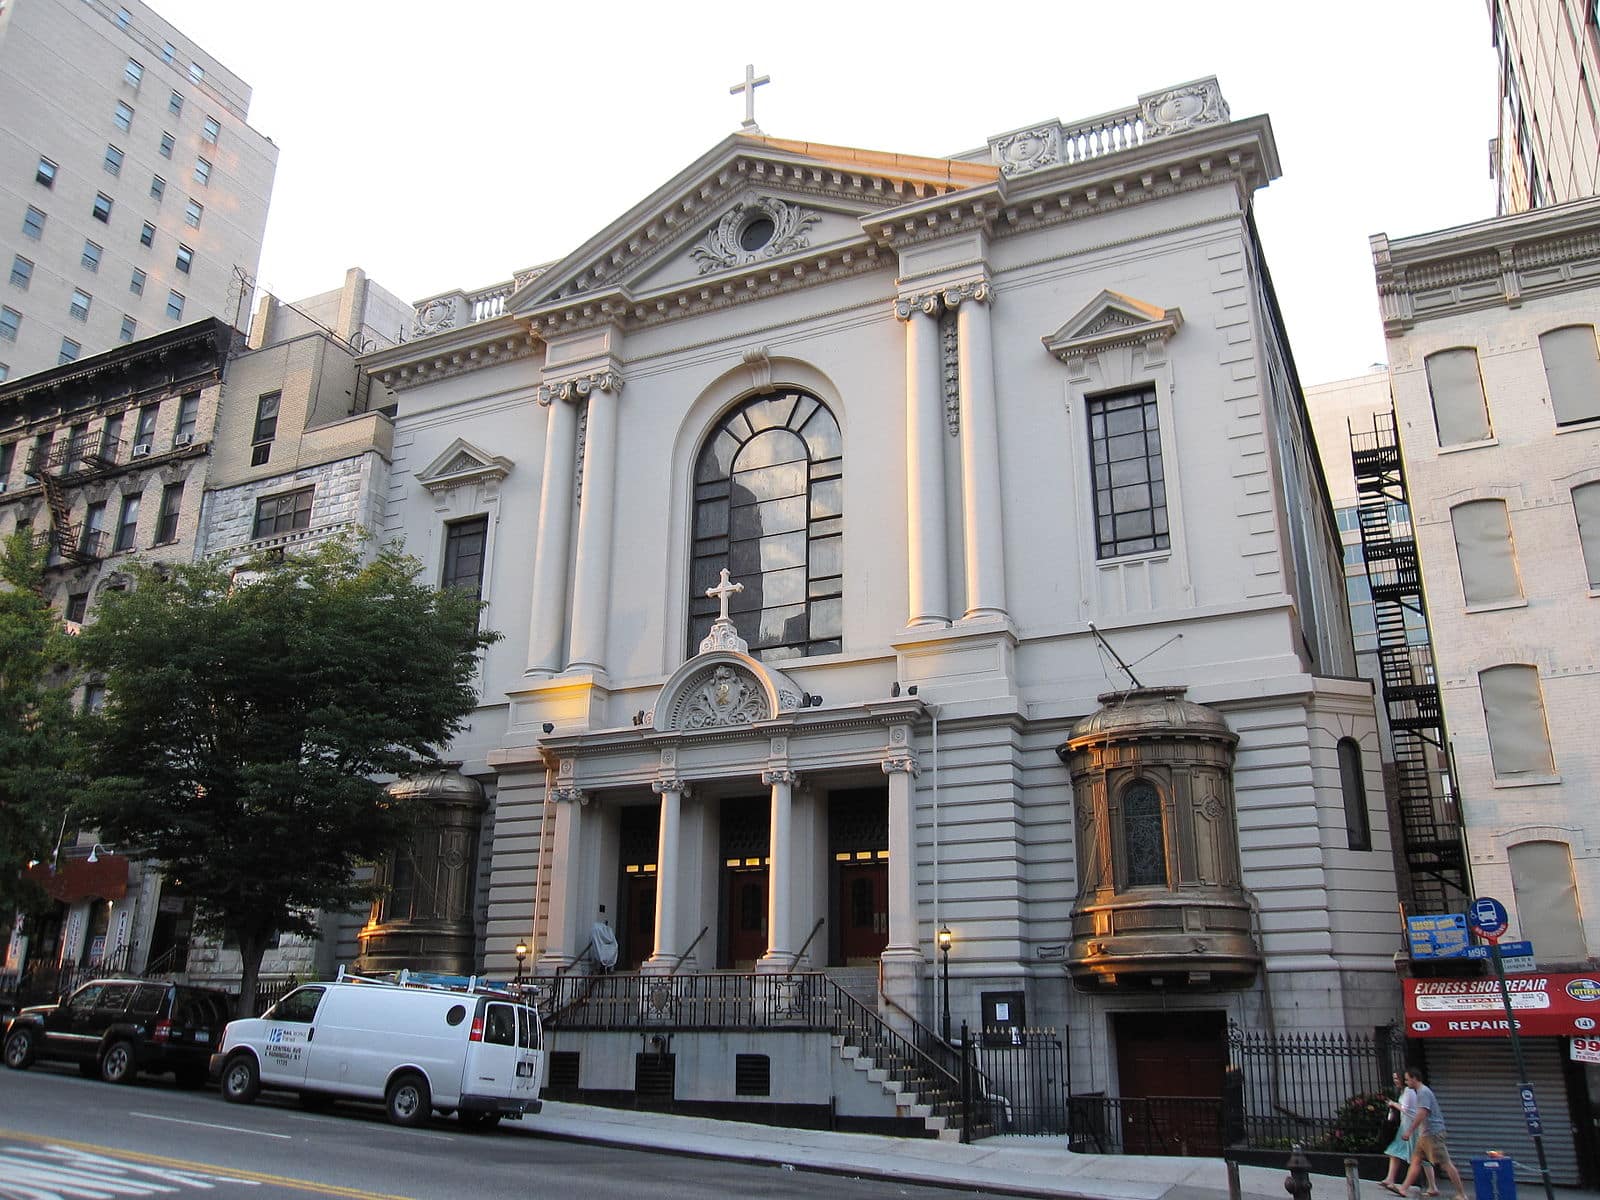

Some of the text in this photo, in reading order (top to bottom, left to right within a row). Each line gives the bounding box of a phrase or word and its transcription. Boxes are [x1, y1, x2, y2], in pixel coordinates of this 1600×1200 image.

[1414, 979, 1547, 995] EXPRESS SHOE REPAIR
[1448, 1020, 1522, 1031] REPAIRS
